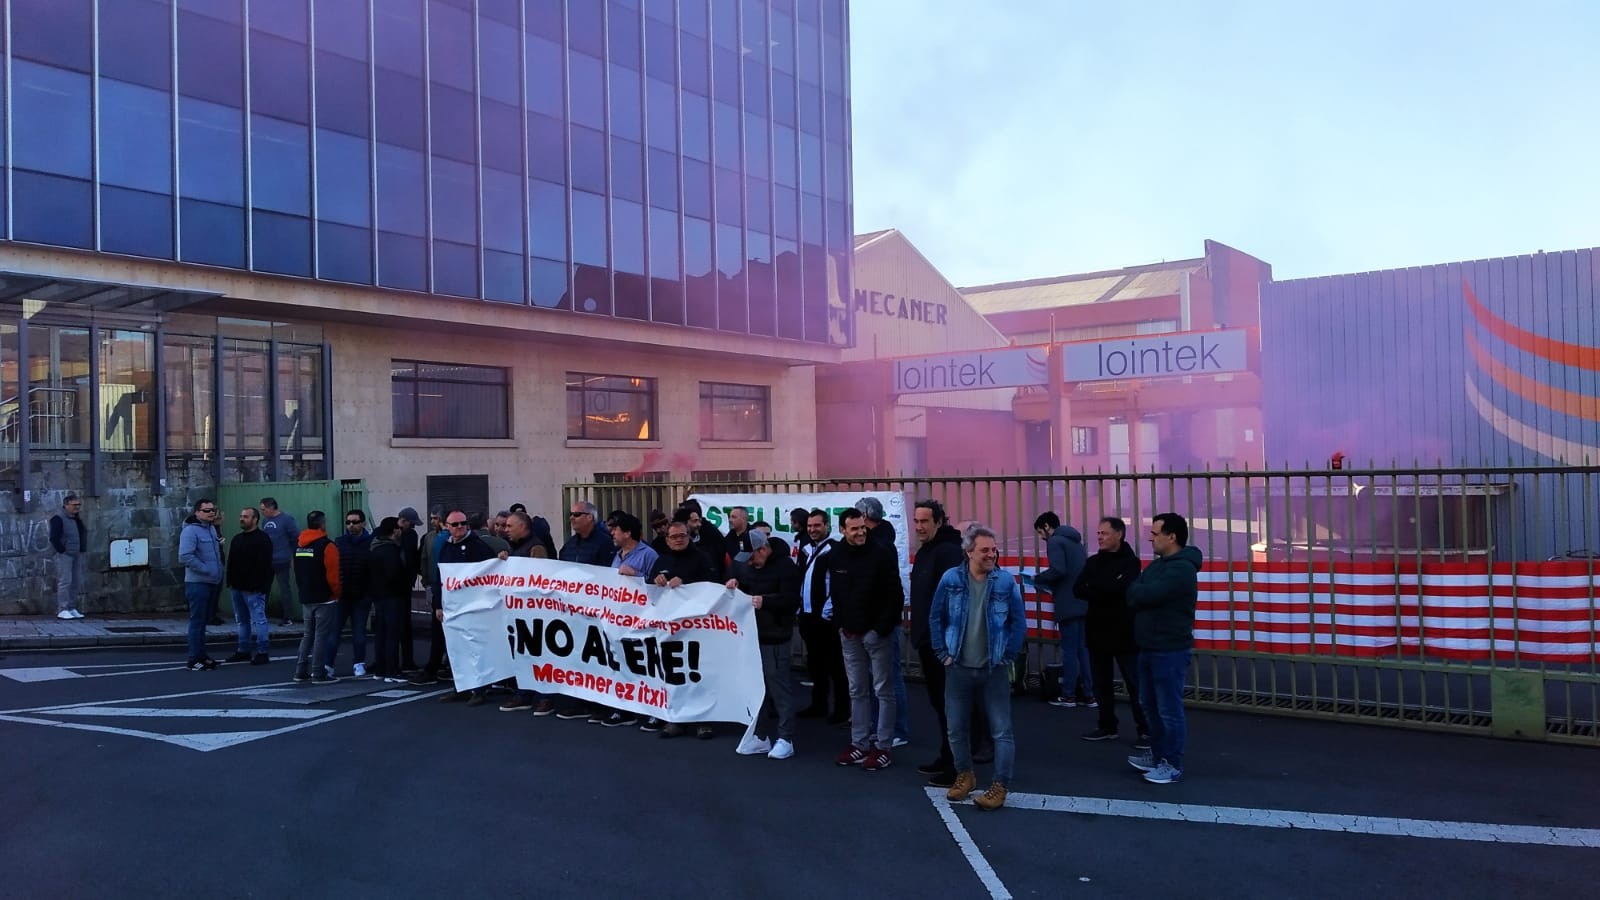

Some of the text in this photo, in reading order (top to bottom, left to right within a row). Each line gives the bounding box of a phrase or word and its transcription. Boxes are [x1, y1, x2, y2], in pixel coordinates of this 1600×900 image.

[854, 288, 947, 325] MECANER
[897, 354, 995, 390] lointek
[1098, 335, 1221, 377] lointek
[497, 575, 525, 588] para
[528, 574, 583, 593] Mecaner
[585, 582, 599, 595] es
[505, 594, 523, 609] Un
[506, 618, 574, 660] ¡NO
[620, 636, 702, 686] ERE!
[532, 663, 668, 709] Mecaner ez itxi!
